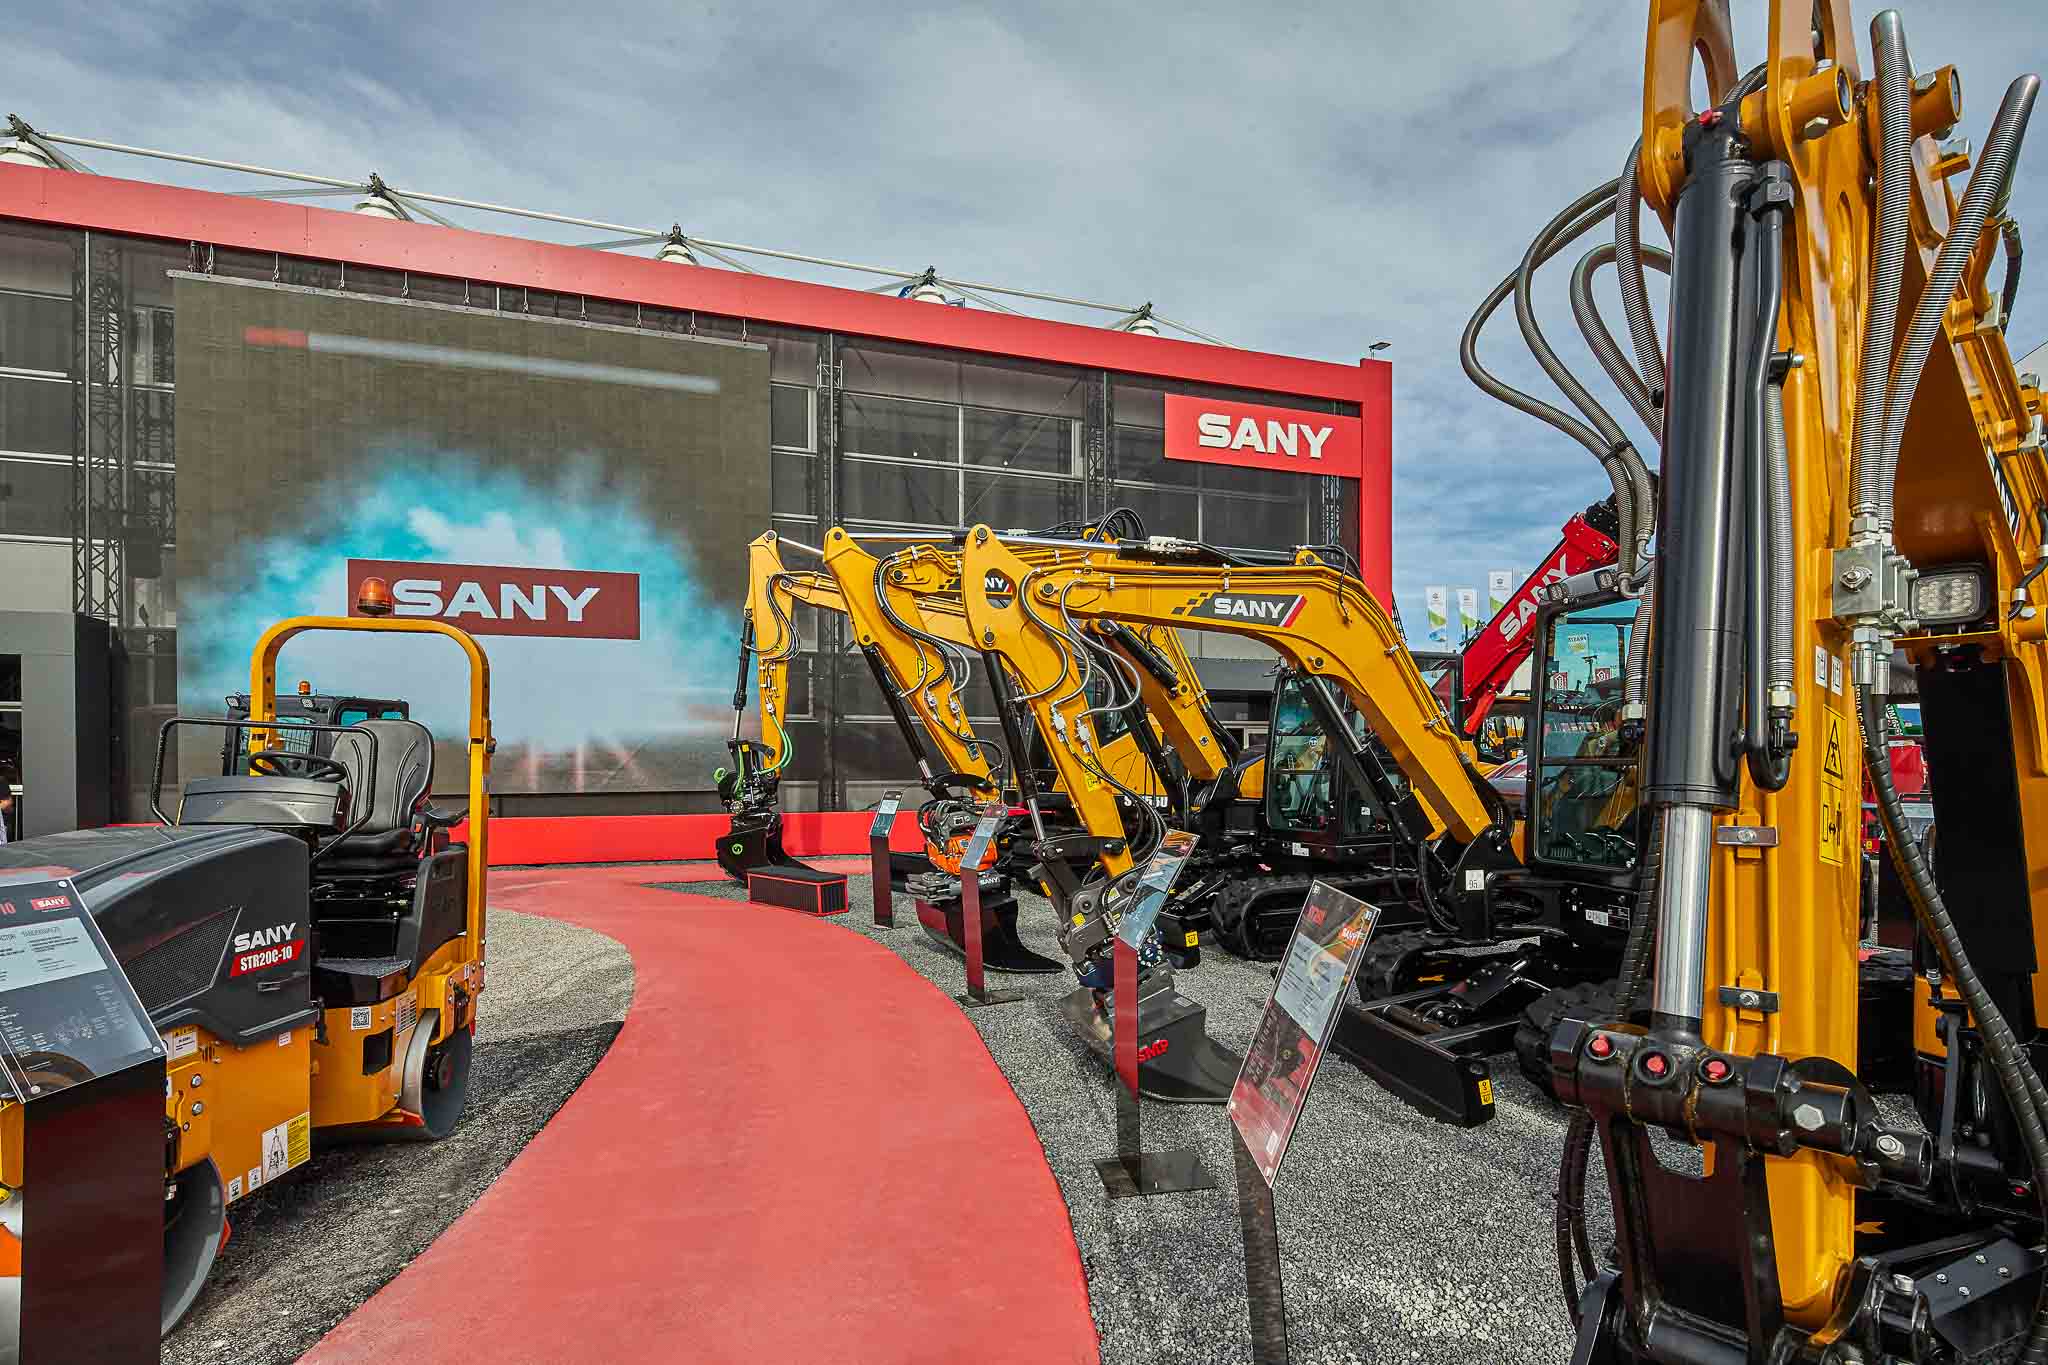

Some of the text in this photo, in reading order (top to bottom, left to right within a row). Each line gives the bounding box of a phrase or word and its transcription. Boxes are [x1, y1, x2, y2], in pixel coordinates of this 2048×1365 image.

[1197, 413, 1334, 459] SANY
[984, 577, 1005, 589] NY
[391, 578, 601, 622] SANY
[1213, 598, 1285, 619] SANY
[37, 898, 65, 908] SANY
[234, 923, 297, 953] SANY
[239, 946, 294, 972] STR20C-10
